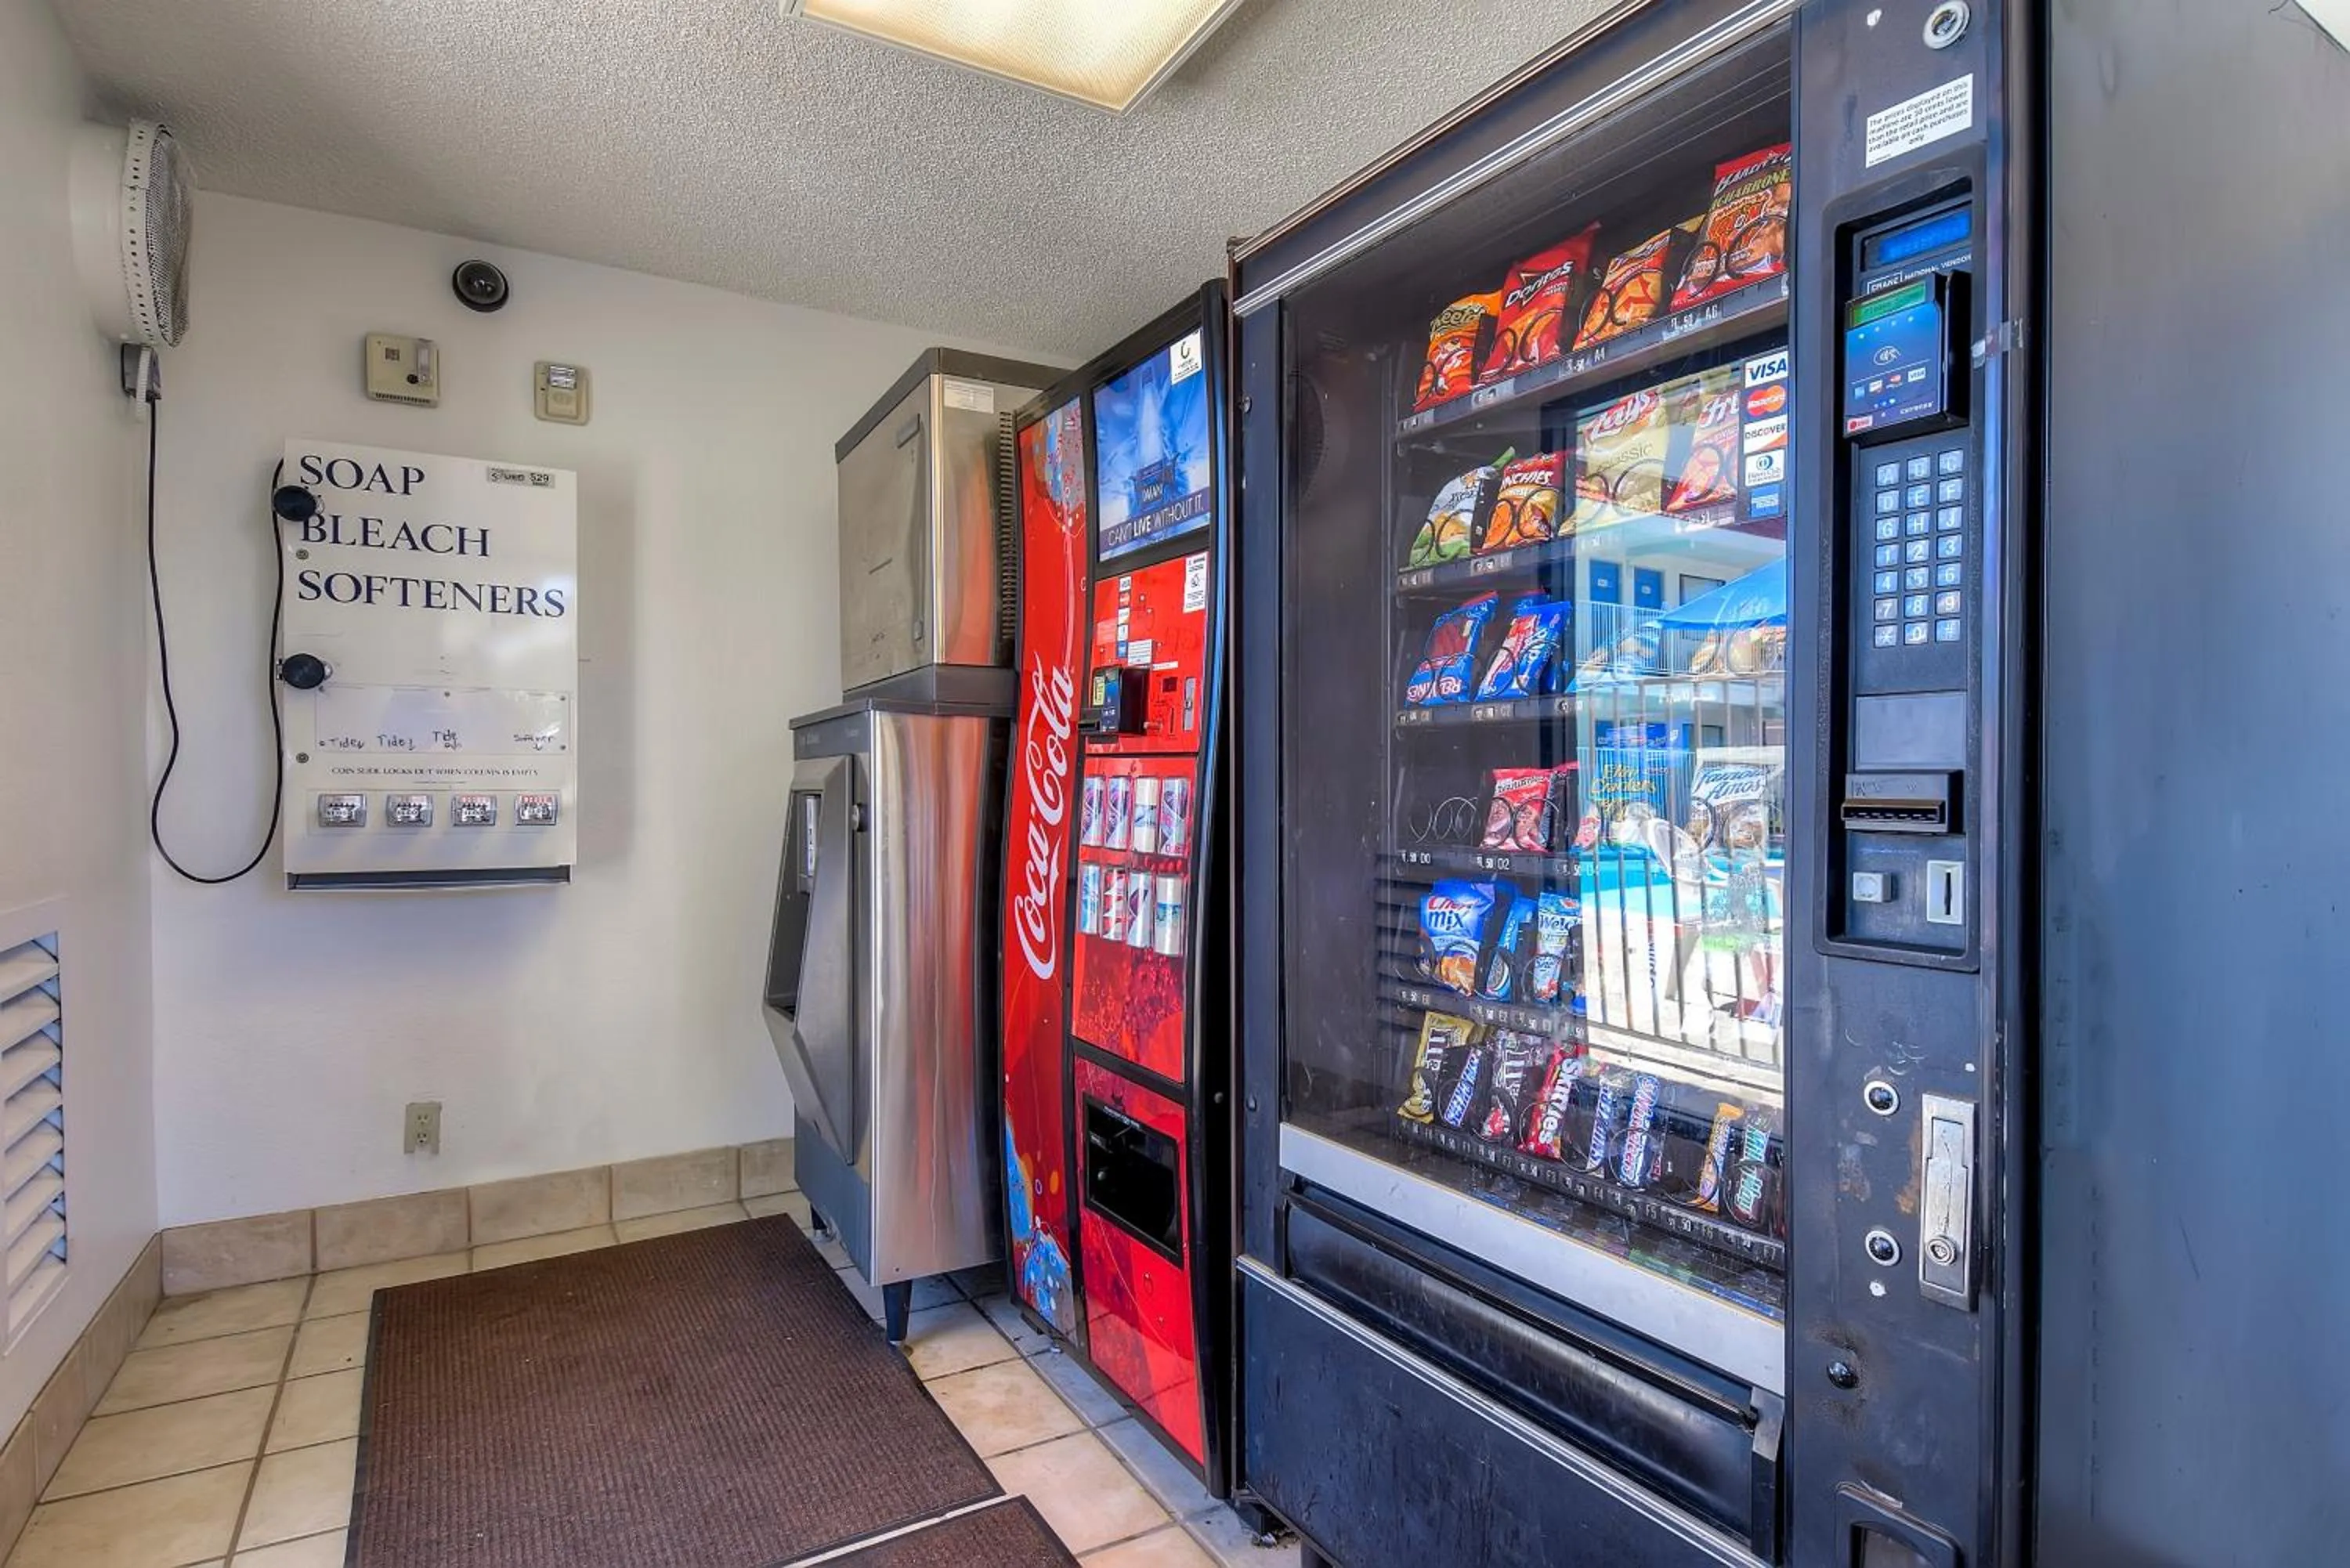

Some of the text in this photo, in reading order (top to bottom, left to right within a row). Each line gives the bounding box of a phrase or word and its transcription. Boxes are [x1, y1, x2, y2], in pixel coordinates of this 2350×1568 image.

[1750, 358, 1787, 381] VISA
[1590, 392, 1651, 439] Lay's
[1745, 424, 1786, 439] DISCOVER
[300, 455, 425, 496] SOAP
[1883, 468, 1893, 483] A
[1947, 456, 1955, 471] C
[1884, 483, 1955, 511] D E F
[1133, 515, 1151, 537] LIVE
[1152, 497, 1193, 529] WITHOUT
[1195, 494, 1204, 514] IT.
[1883, 511, 1955, 537] G H J
[301, 513, 490, 557] BLEACH
[1885, 540, 1955, 562] 1 2 3
[1882, 567, 1954, 591] 4 5 6
[298, 569, 566, 618] SOFTENERS
[1883, 595, 1954, 618] 7 8 9
[383, 767, 414, 775] LOCKS
[1694, 766, 1769, 792] Famous
[1708, 782, 1761, 801] Amos
[1014, 651, 1074, 980] Coca-Cola
[1427, 909, 1464, 930] mix
[1538, 1057, 1583, 1144] Skittles
[1735, 1173, 1763, 1214] Way
